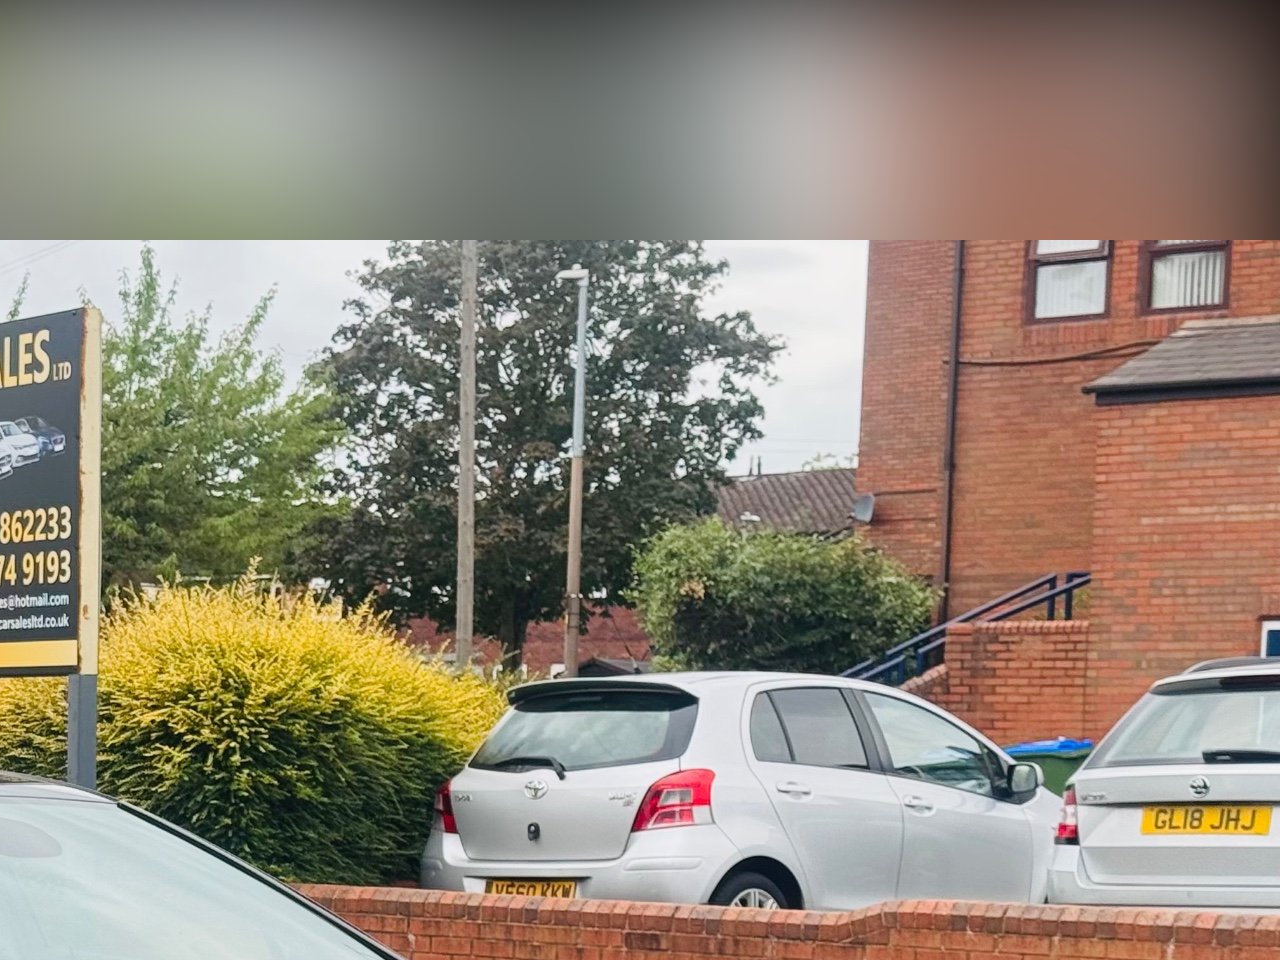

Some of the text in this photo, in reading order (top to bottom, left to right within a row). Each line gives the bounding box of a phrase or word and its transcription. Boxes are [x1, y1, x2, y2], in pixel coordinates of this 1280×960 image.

[52, 361, 72, 381] LTD
[0, 505, 72, 544] 862233
[22, 549, 71, 586] 9193
[1154, 808, 1257, 830] GL18 JHJ
